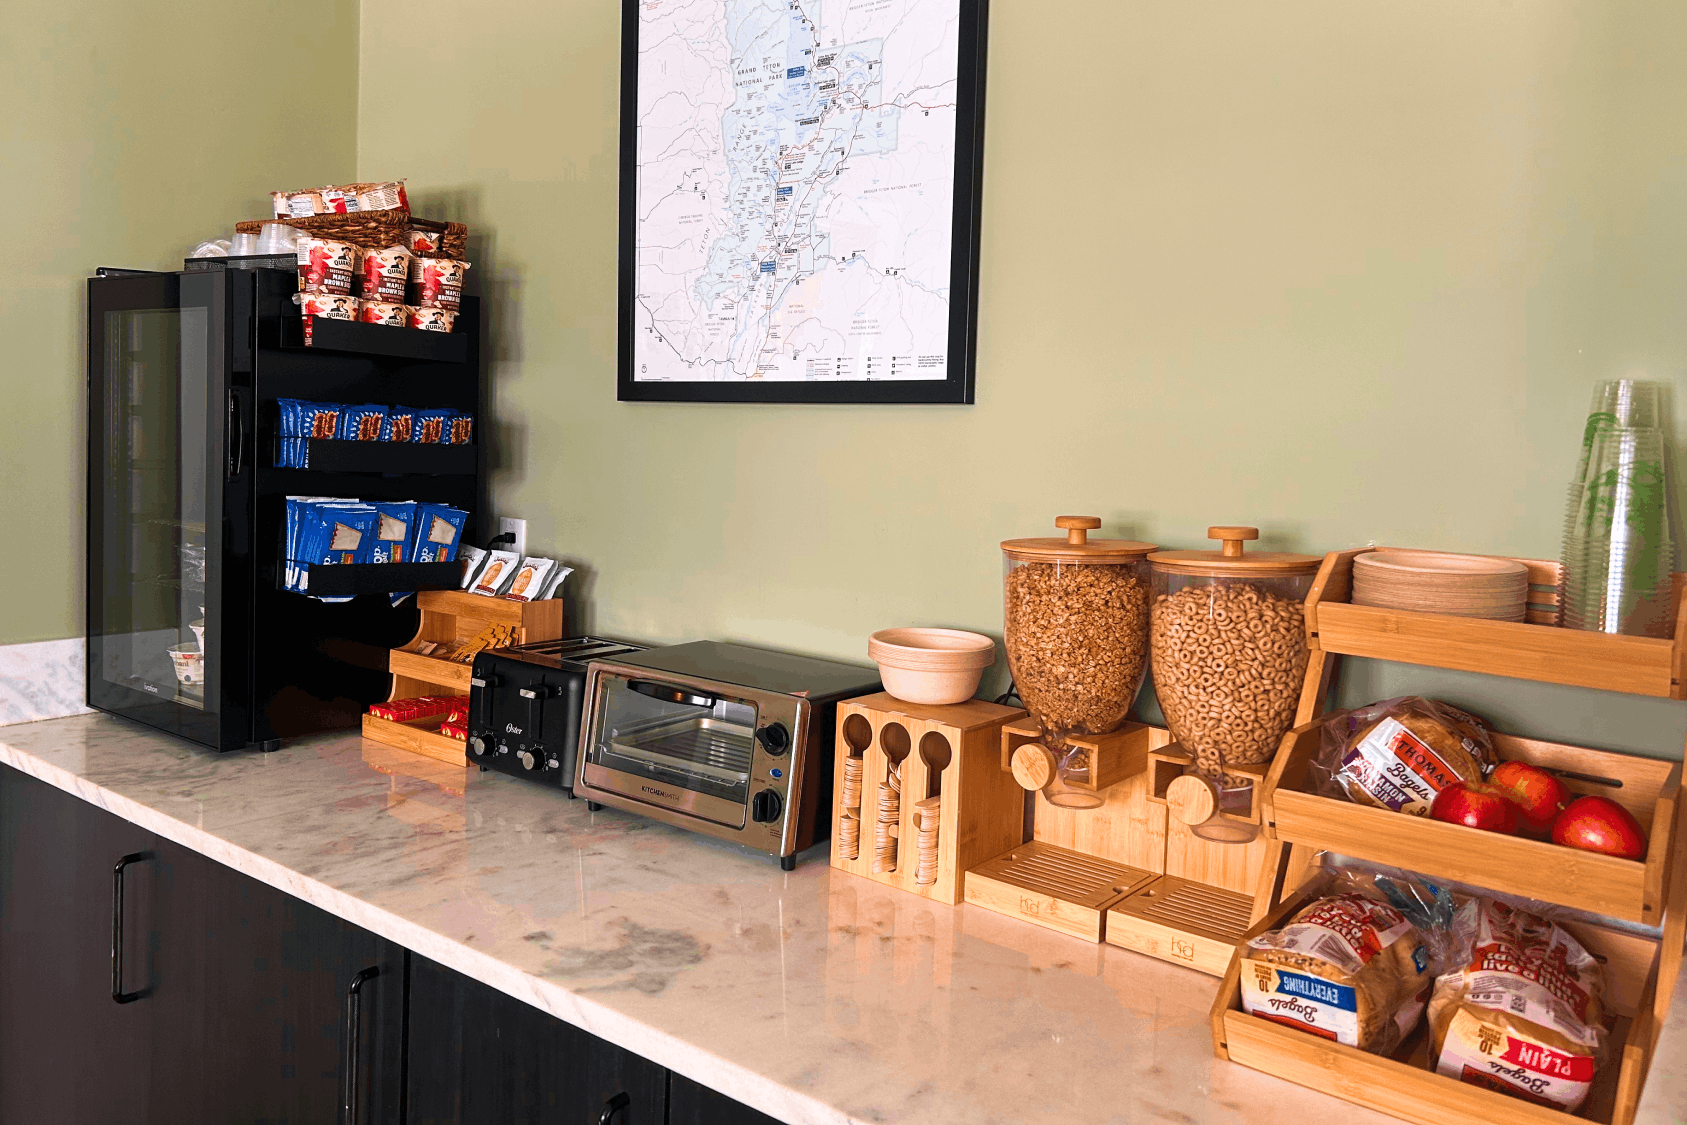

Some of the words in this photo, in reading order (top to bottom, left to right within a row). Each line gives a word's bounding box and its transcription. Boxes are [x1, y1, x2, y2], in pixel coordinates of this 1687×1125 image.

[737, 67, 757, 75] GRAND
[763, 62, 781, 70] TETON
[735, 78, 762, 87] NATIONAL
[699, 227, 710, 253] TETON
[378, 287, 397, 295] BROWN
[326, 312, 351, 320] QUAKER
[505, 722, 523, 734] Oster
[1386, 762, 1430, 801] Bagels
[1258, 979, 1270, 993] 10
[1283, 976, 1339, 1004] EVERYTHING
[1267, 997, 1318, 1023] Bagels
[1479, 1039, 1494, 1056] 10
[1518, 1044, 1572, 1075] PLAIN
[1487, 1061, 1551, 1094] Bagels
